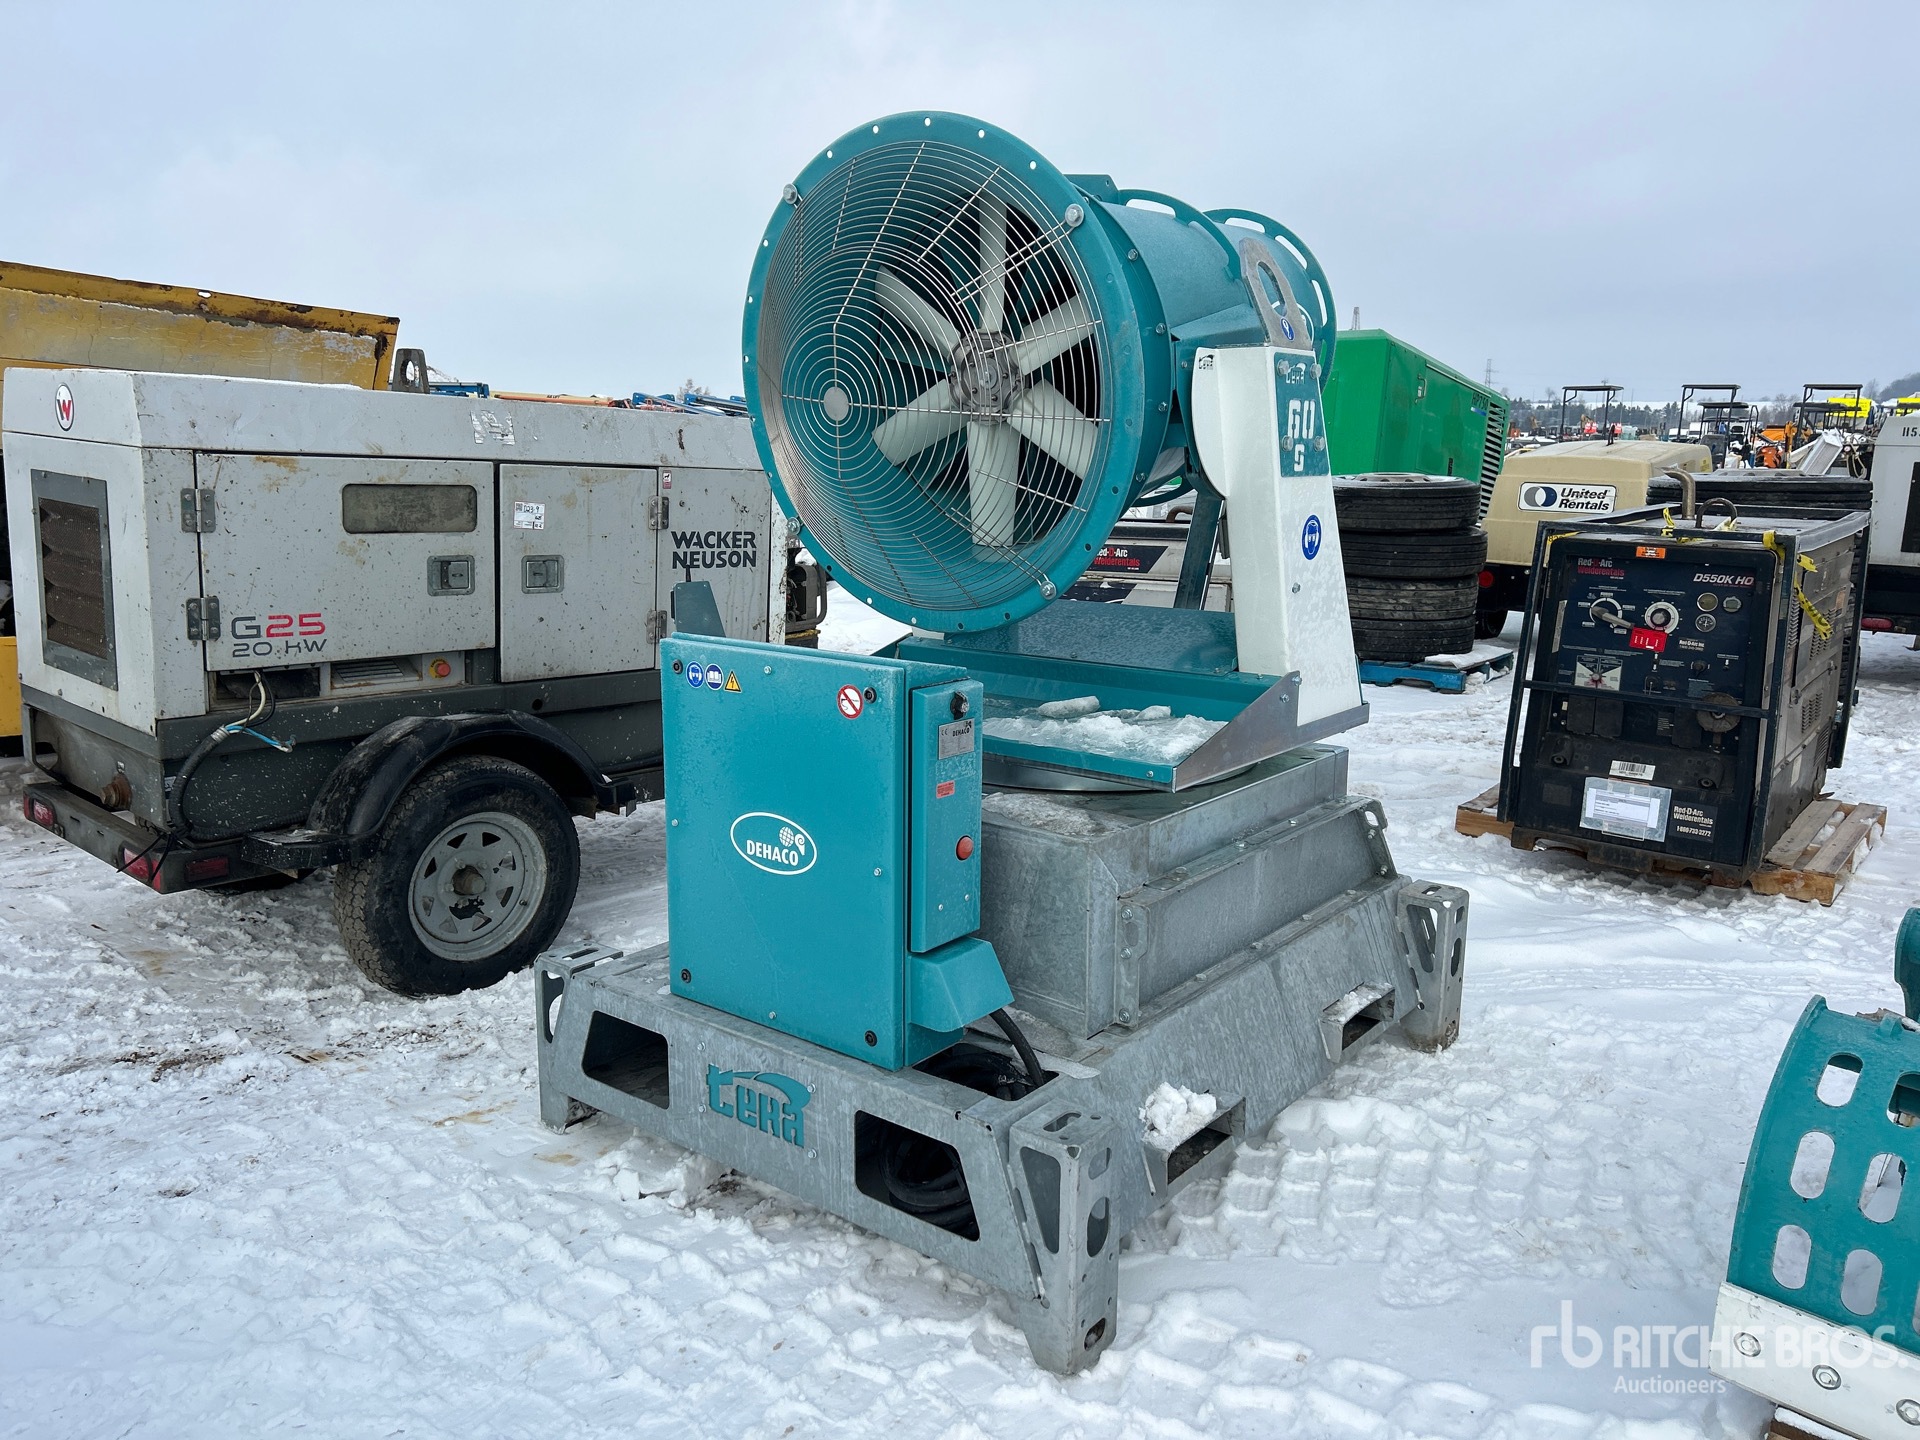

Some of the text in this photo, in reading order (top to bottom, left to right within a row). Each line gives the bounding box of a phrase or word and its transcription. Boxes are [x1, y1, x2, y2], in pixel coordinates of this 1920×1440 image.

[1902, 427, 1920, 437] 115
[1561, 487, 1607, 499] United
[1559, 498, 1609, 511] Rentals
[671, 531, 757, 549] WACKER
[1097, 547, 1128, 558] ed-D-Arc
[672, 550, 757, 569] NEUSON
[1094, 556, 1141, 567] Welderentals
[1693, 573, 1733, 584] D550K
[231, 612, 326, 640] G25
[232, 641, 273, 658] 20
[952, 727, 970, 737] DEHACO
[746, 839, 799, 867] DEHACO
